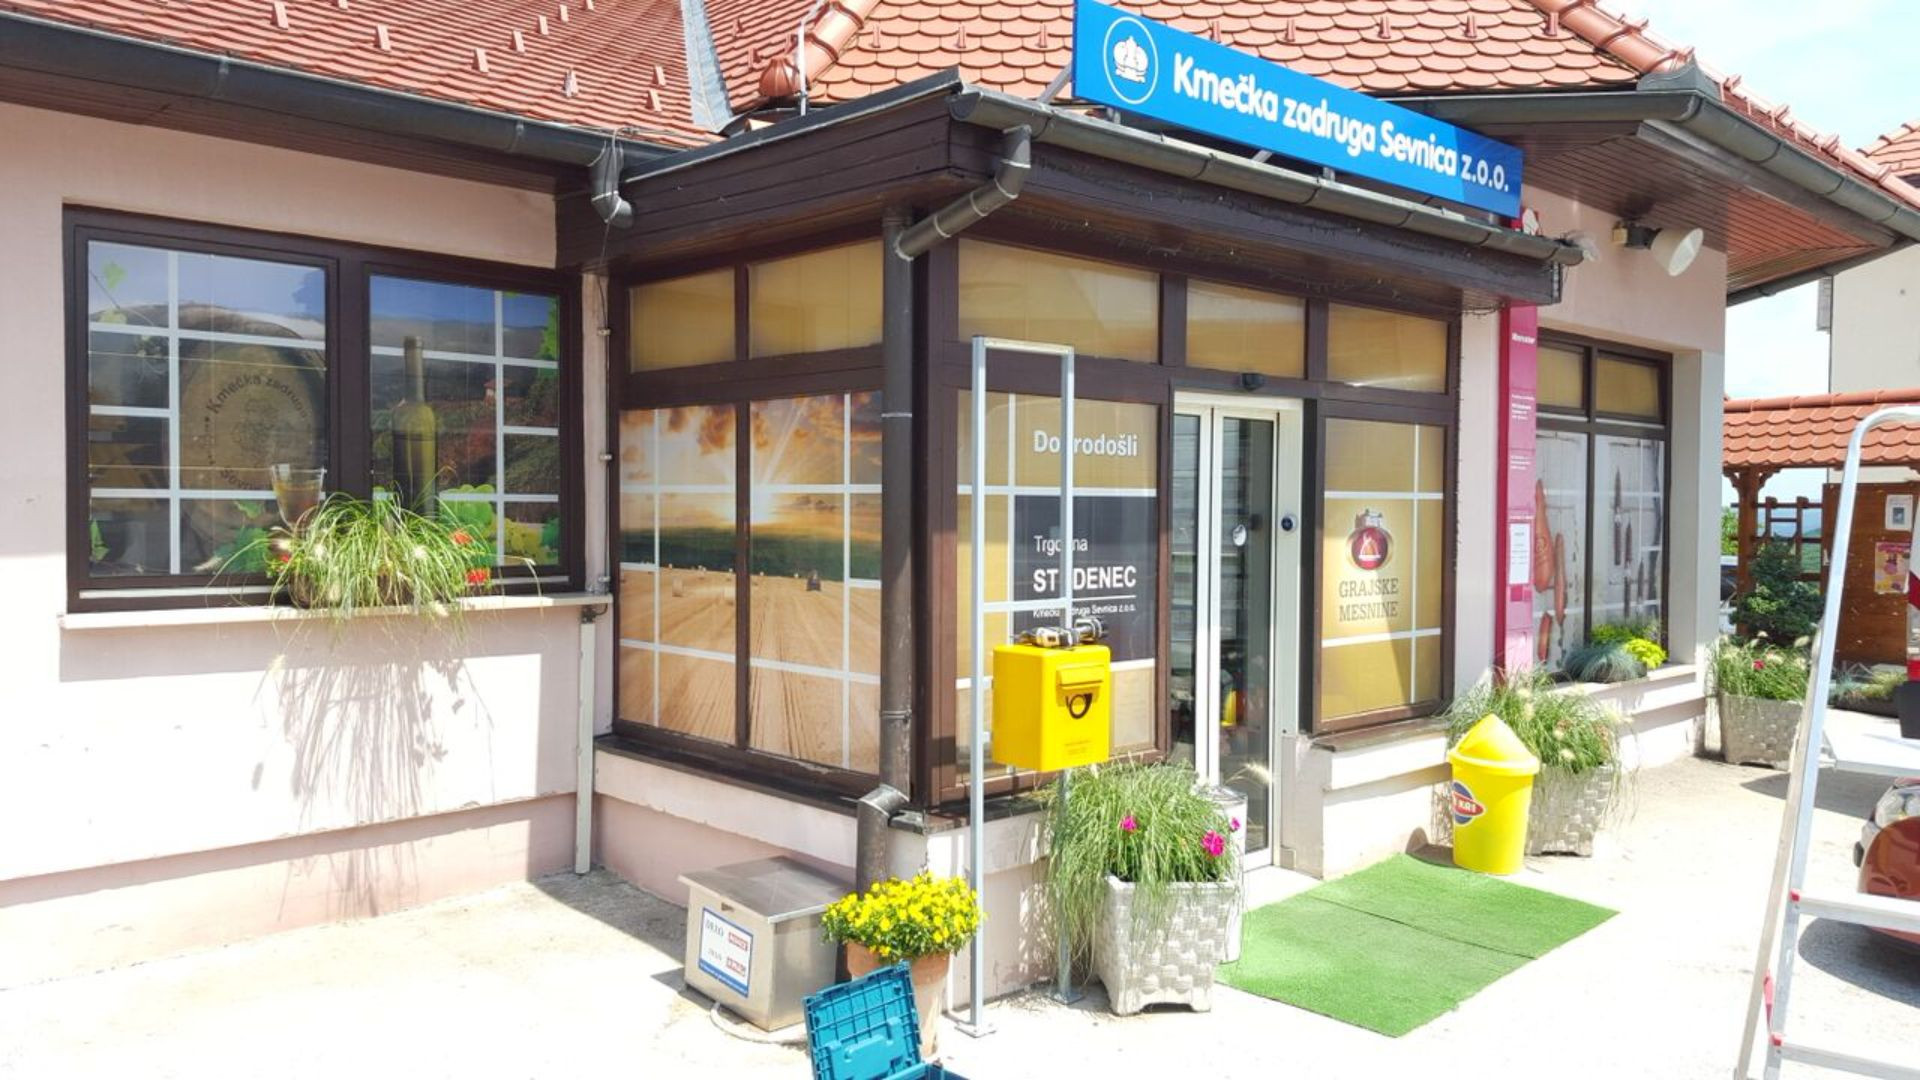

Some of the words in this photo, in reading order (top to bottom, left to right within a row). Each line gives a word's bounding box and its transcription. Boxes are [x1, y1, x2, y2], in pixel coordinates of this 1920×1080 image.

[1173, 53, 1279, 122] Kmečka
[1283, 98, 1376, 157] zadruga
[1380, 120, 1457, 176] Sevnica
[1461, 154, 1509, 192] z.o.o.
[1033, 430, 1138, 456] Dorodošli
[1034, 535, 1088, 556] Trgona
[1033, 565, 1137, 592] STDENEC
[1338, 578, 1399, 598] GRAJSKE
[1339, 601, 1398, 622] MESNINE
